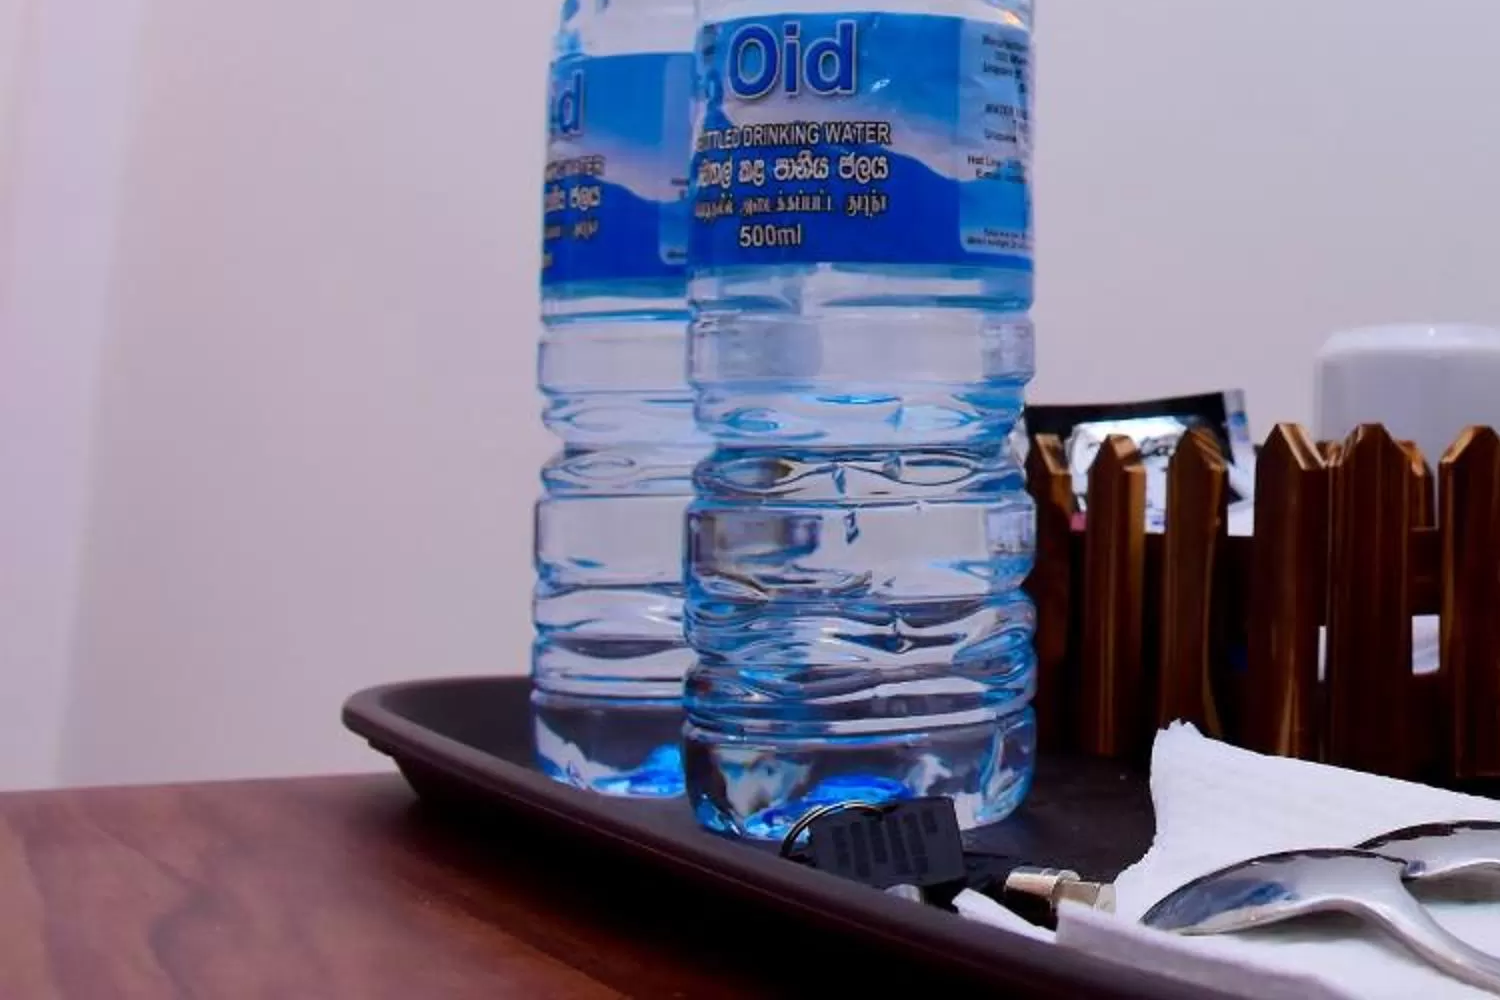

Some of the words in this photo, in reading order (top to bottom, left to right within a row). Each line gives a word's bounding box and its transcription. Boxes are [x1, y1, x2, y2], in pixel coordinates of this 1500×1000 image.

[727, 19, 857, 99] Oid
[742, 123, 820, 147] DRINKING
[824, 121, 893, 145] WATER
[739, 223, 802, 248] 500ml
